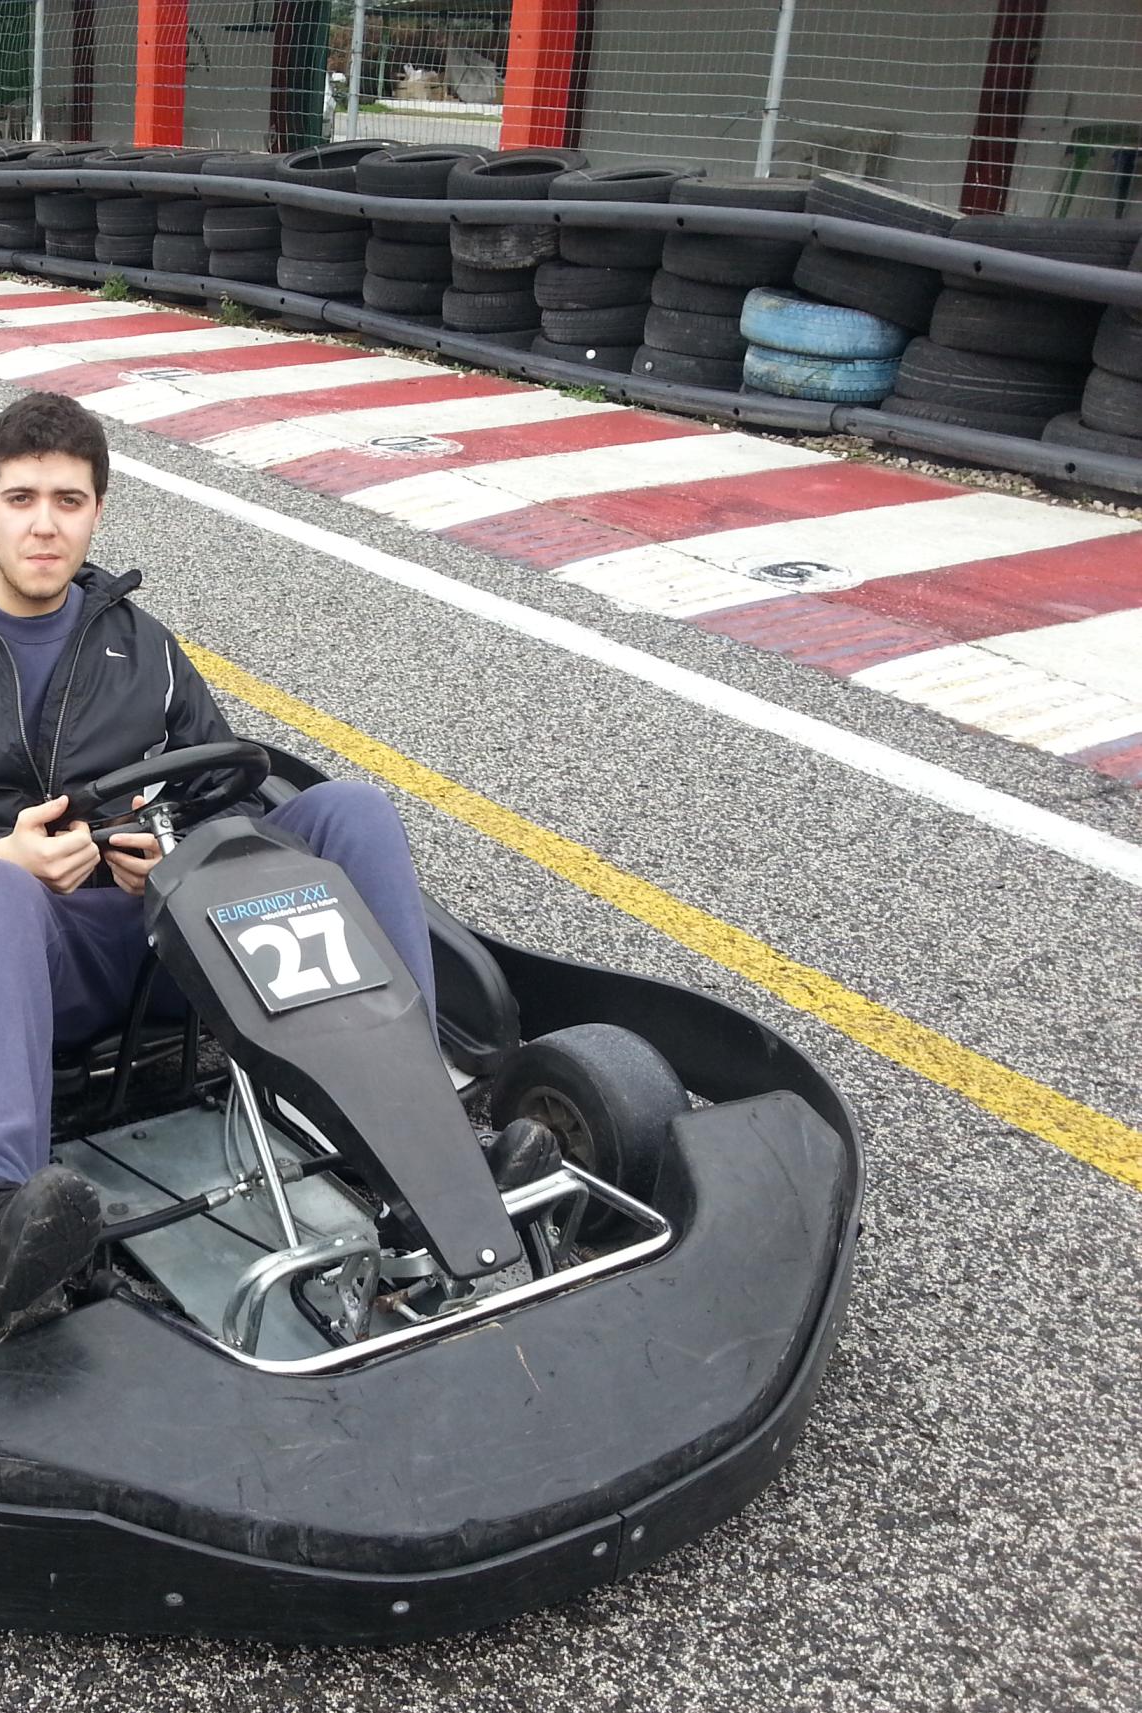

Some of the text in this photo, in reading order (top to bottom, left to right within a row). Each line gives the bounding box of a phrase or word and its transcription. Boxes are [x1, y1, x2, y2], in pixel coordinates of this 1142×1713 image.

[216, 884, 329, 923] EUROINDY XXI
[237, 909, 361, 1000] 27
